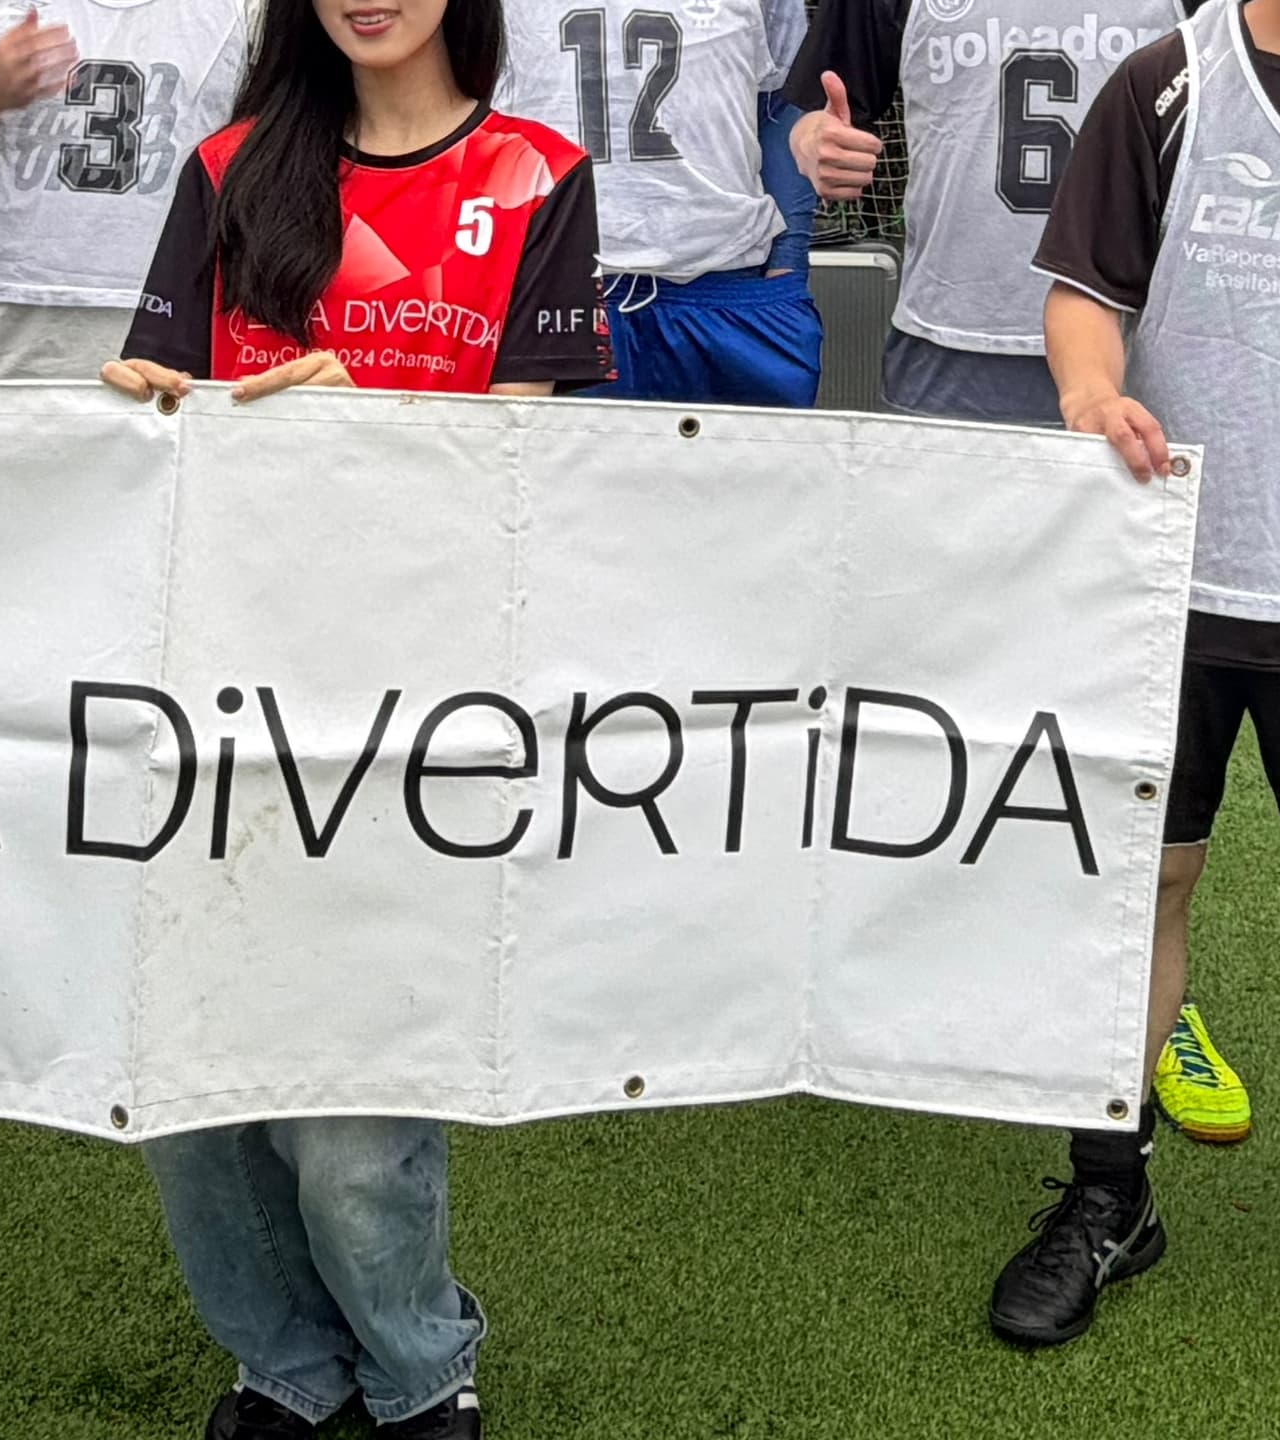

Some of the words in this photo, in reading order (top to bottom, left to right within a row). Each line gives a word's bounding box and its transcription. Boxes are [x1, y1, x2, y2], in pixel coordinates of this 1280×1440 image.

[58, 59, 145, 195] 3
[559, 8, 683, 165] 12
[995, 48, 1078, 214] 6
[455, 197, 495, 256] 5
[537, 308, 585, 334] P.I.F
